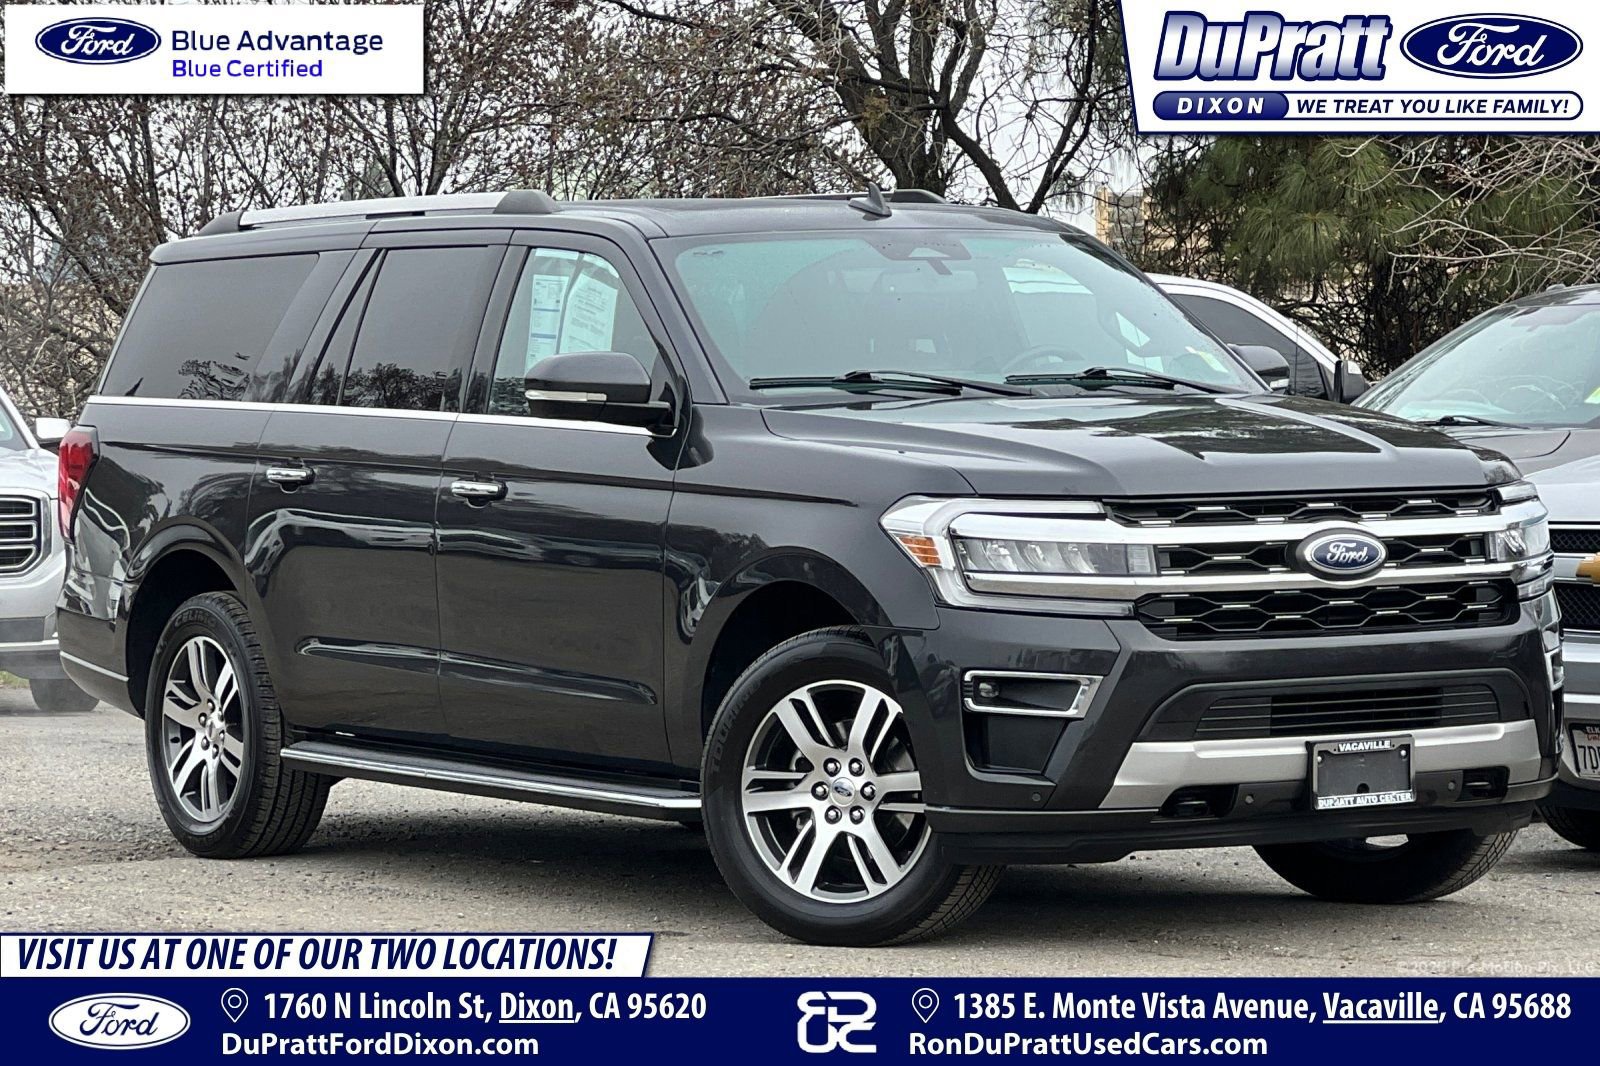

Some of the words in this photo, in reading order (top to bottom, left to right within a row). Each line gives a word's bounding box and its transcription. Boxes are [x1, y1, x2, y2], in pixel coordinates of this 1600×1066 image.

[1326, 541, 1369, 564] Ford
[1338, 740, 1392, 752] VACAVILLE
[1578, 745, 1600, 770] 7D
[1356, 794, 1379, 805] AUTO
